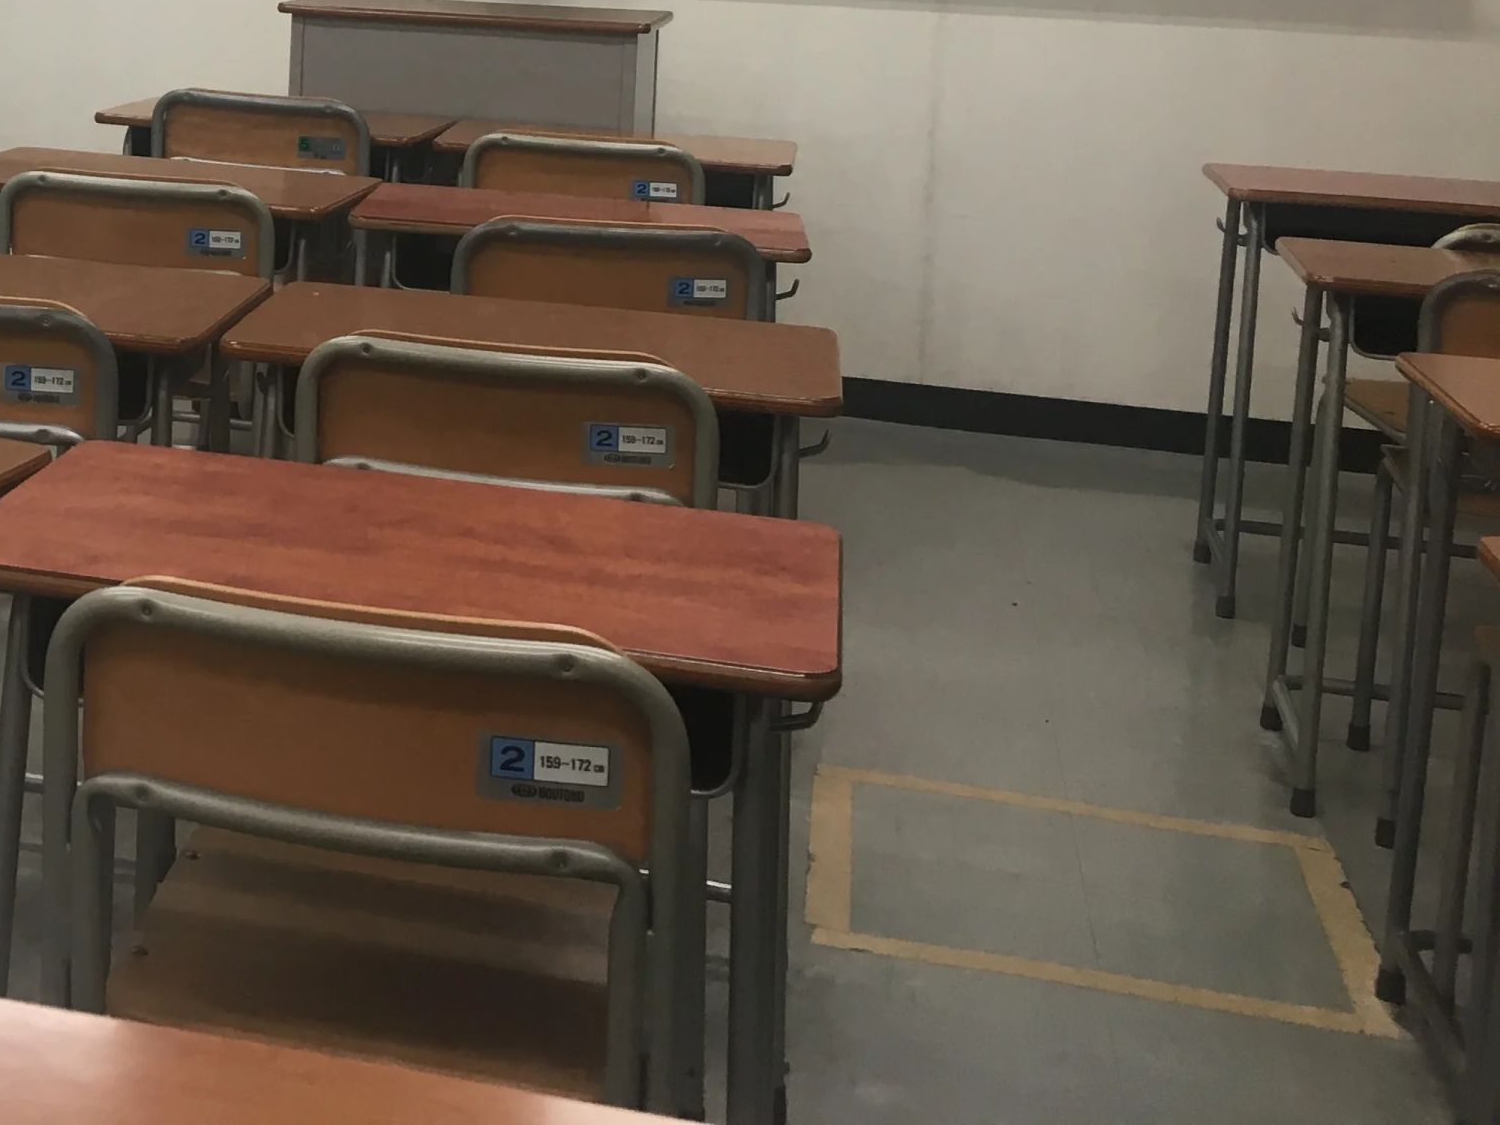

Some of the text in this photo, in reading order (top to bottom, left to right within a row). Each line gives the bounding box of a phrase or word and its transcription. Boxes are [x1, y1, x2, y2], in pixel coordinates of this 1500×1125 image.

[636, 183, 647, 194] 2
[194, 232, 206, 245] 2
[678, 282, 690, 295] 2
[10, 370, 26, 386] 2
[596, 430, 613, 446] 2
[500, 745, 526, 772] 2
